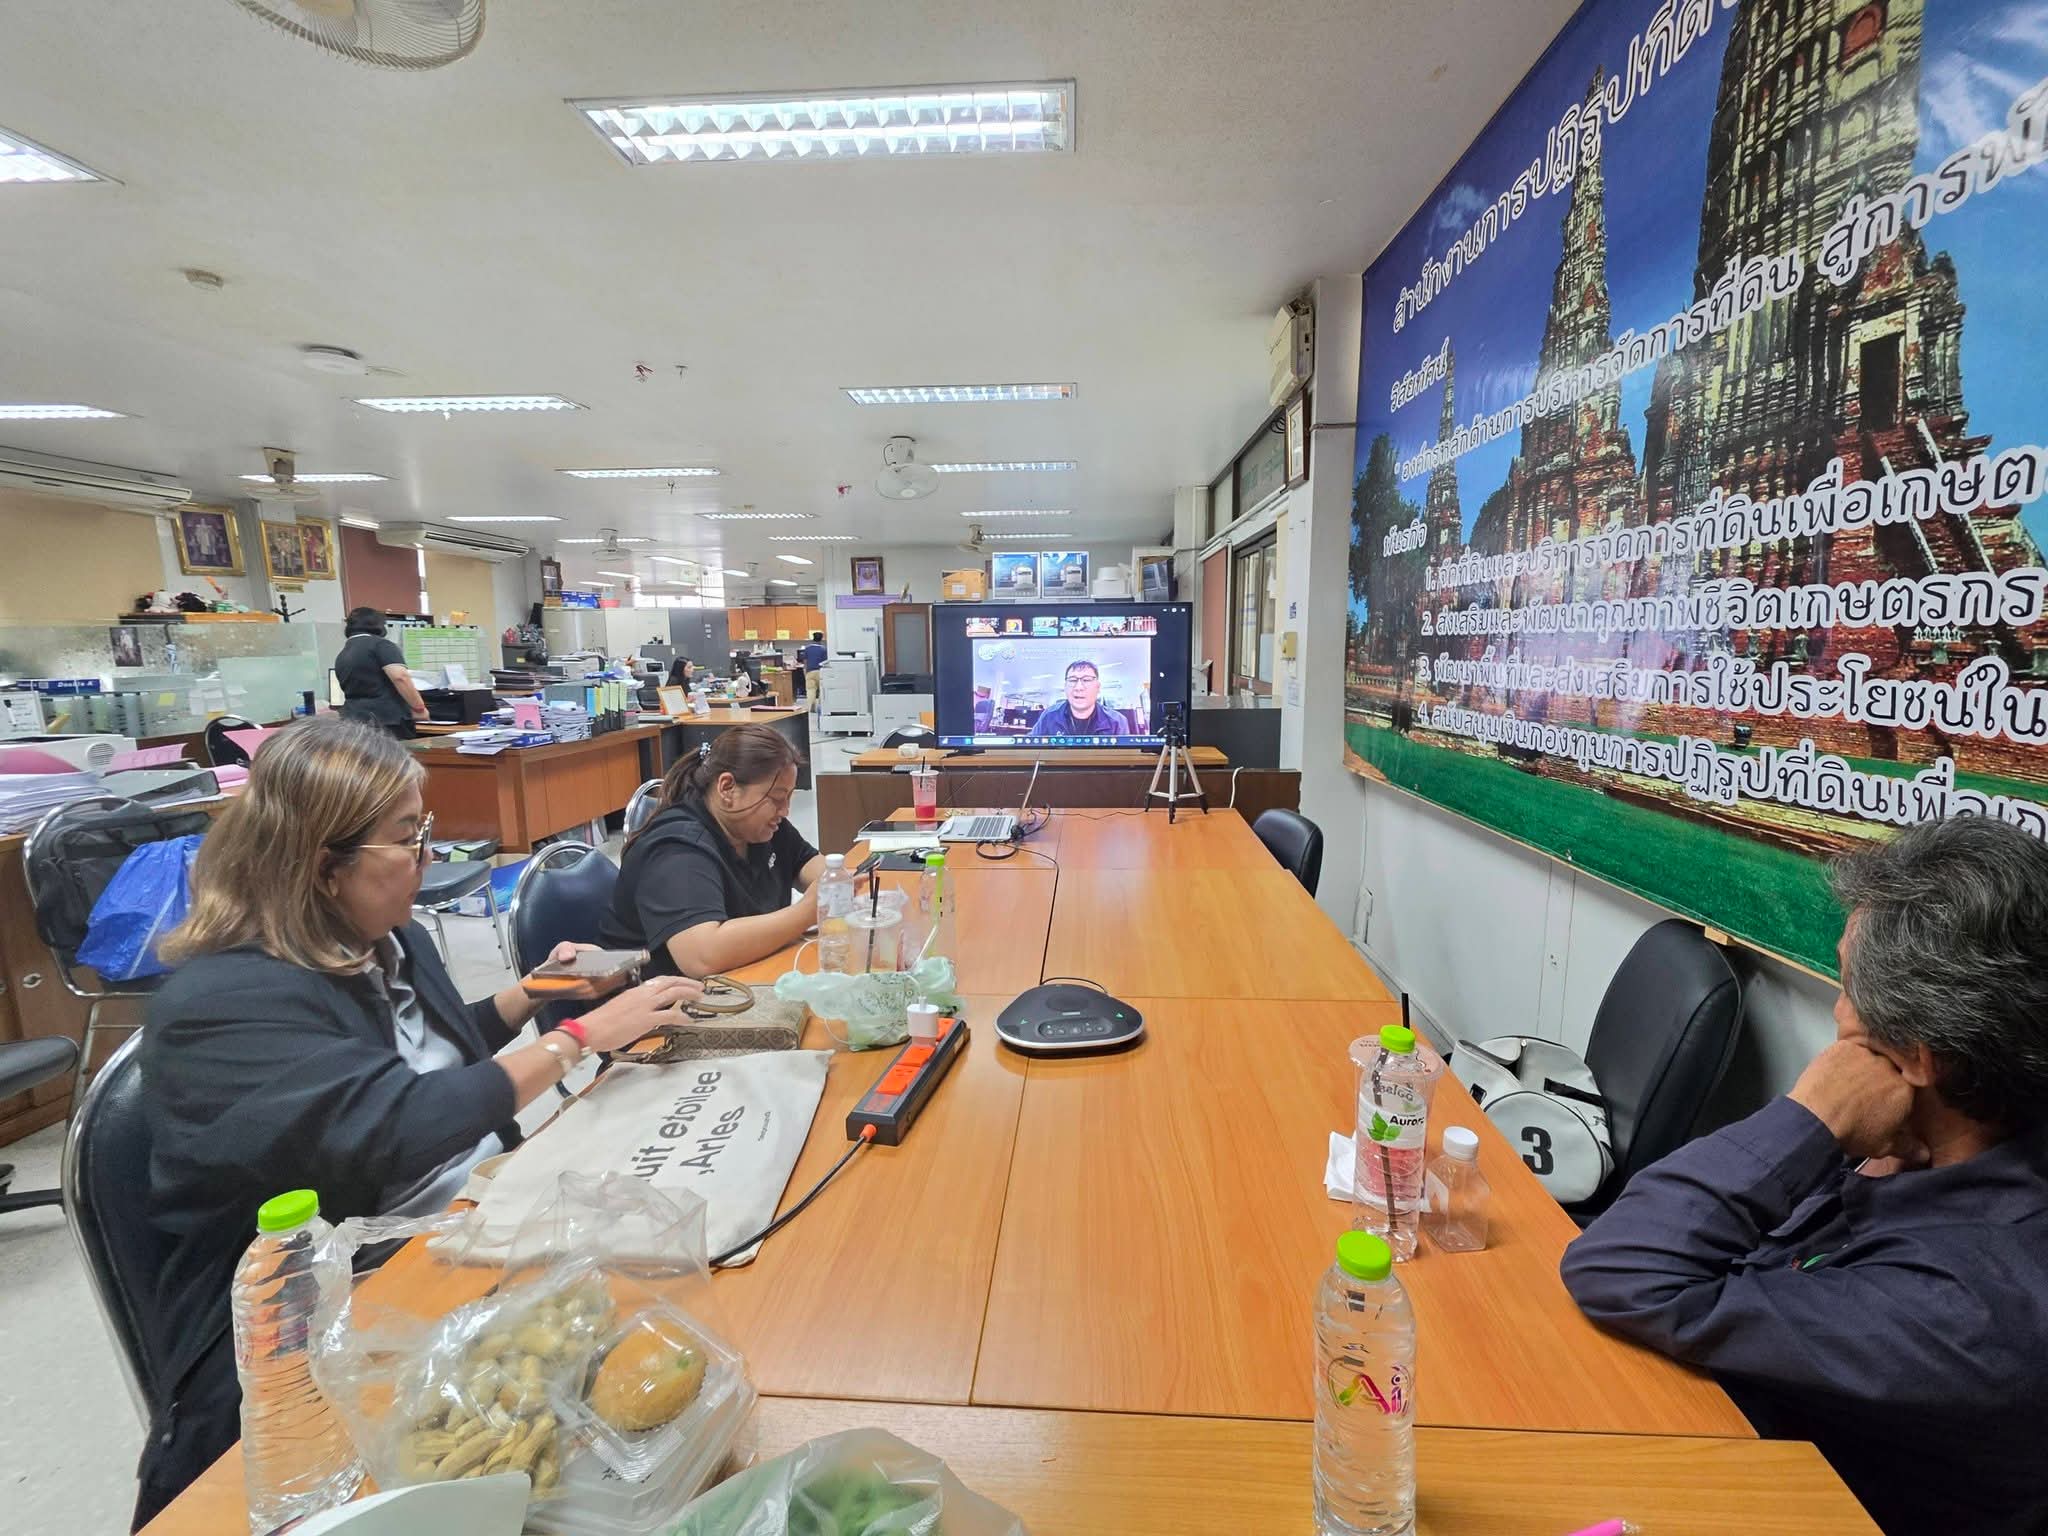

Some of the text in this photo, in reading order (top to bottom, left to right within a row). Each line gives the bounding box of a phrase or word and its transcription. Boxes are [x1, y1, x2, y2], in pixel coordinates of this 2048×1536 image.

[1391, 338, 1450, 412] วิสัยทัศน์
[1383, 520, 1428, 556] พันธกิจ
[1425, 567, 1437, 591] 1.
[1421, 570, 2044, 642] 2. ส่งเสริมและพัฒนาคุณภาพชีวิตเกษตรกร
[1419, 656, 1431, 682] 3.
[1418, 701, 1430, 725] 4.
[632, 1145, 676, 1181] uit
[1521, 1126, 1554, 1175] 3
